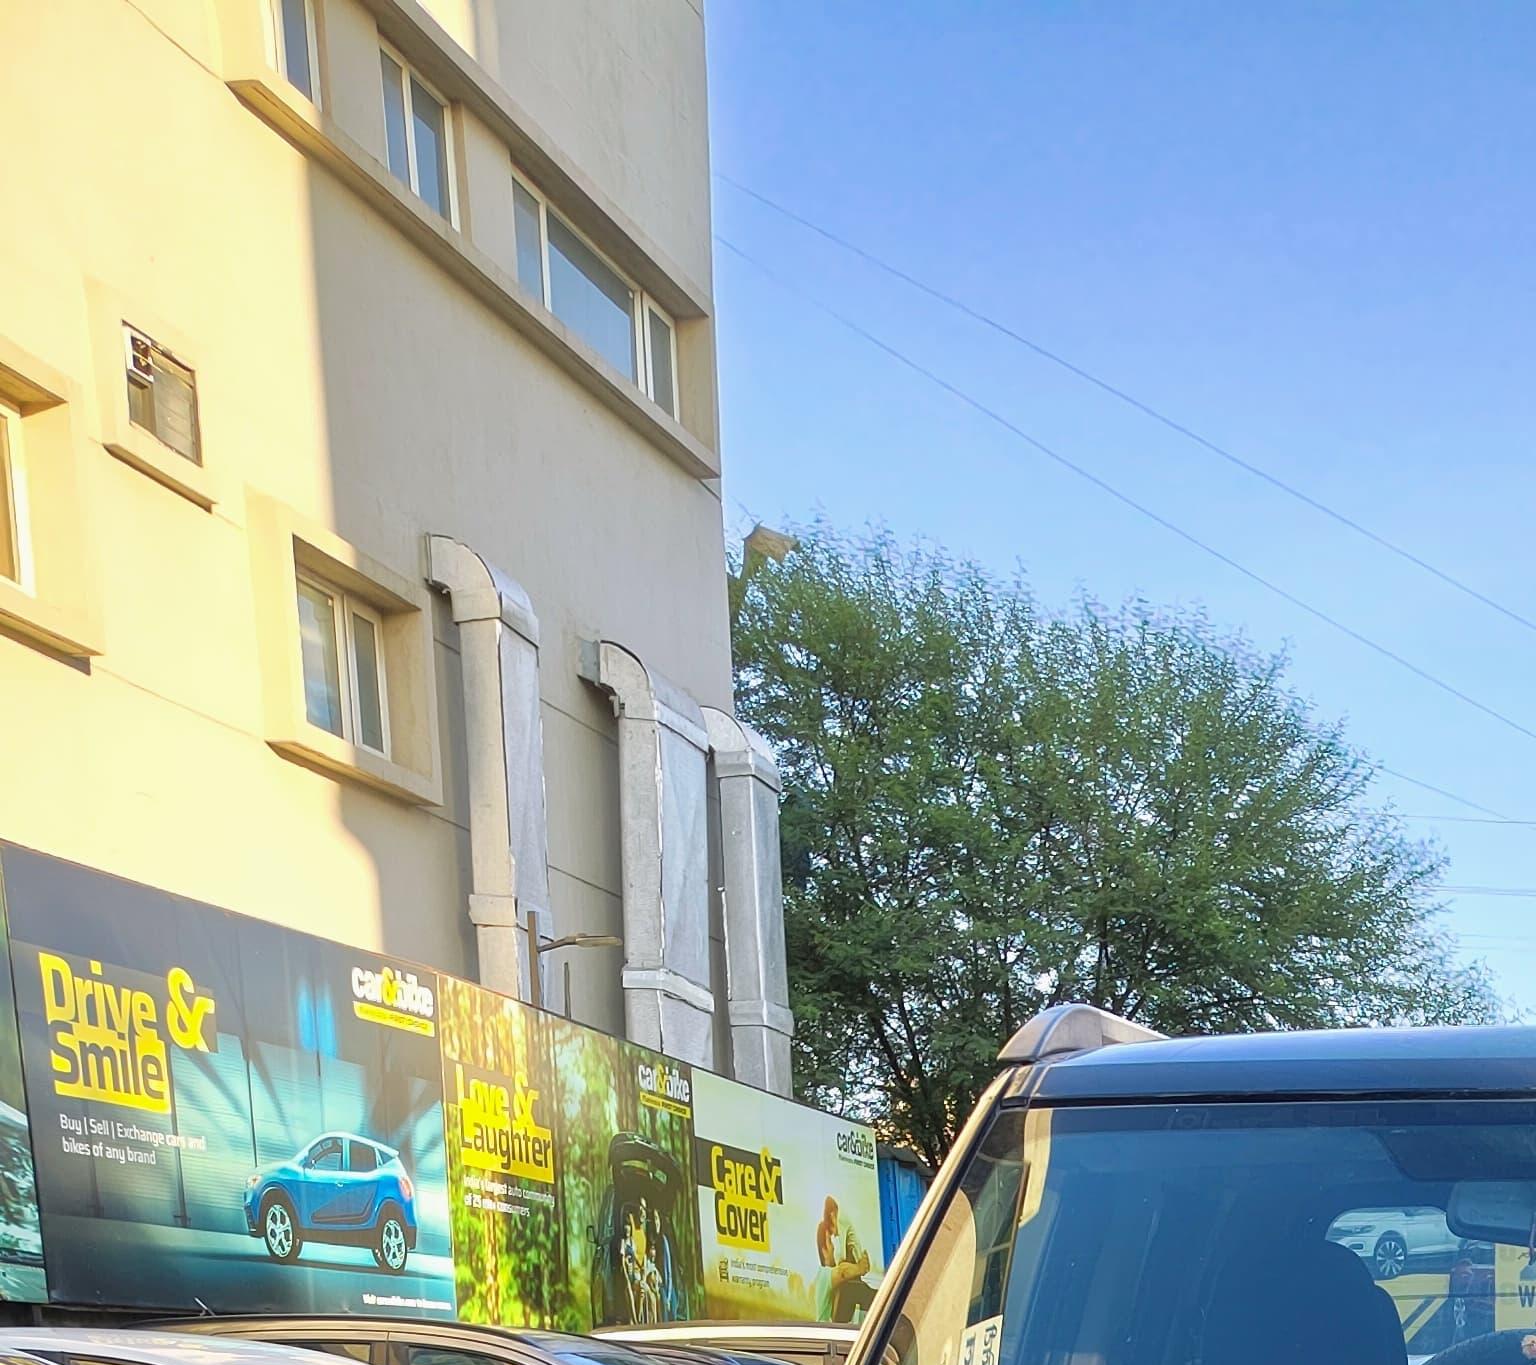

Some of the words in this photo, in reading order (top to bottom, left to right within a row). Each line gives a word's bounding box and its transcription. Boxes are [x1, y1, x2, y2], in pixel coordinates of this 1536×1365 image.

[38, 951, 157, 1037] Drive
[166, 967, 215, 1053] &
[352, 966, 433, 1017] car&bike
[49, 1019, 165, 1101] Smile
[638, 1064, 690, 1103] car&bike
[455, 1063, 510, 1117] Love
[512, 1071, 540, 1126] &
[59, 1113, 82, 1136] Buy
[89, 1117, 110, 1136] Sell
[117, 1123, 165, 1145] Exchange
[62, 1137, 91, 1156] bikes
[92, 1145, 104, 1158] of
[105, 1148, 125, 1164] any
[127, 1149, 156, 1165] brand
[460, 1107, 551, 1170] Laughter
[837, 1130, 874, 1160] car&bike
[711, 1144, 757, 1196] Care
[759, 1146, 782, 1204] &
[714, 1190, 768, 1243] Cover
